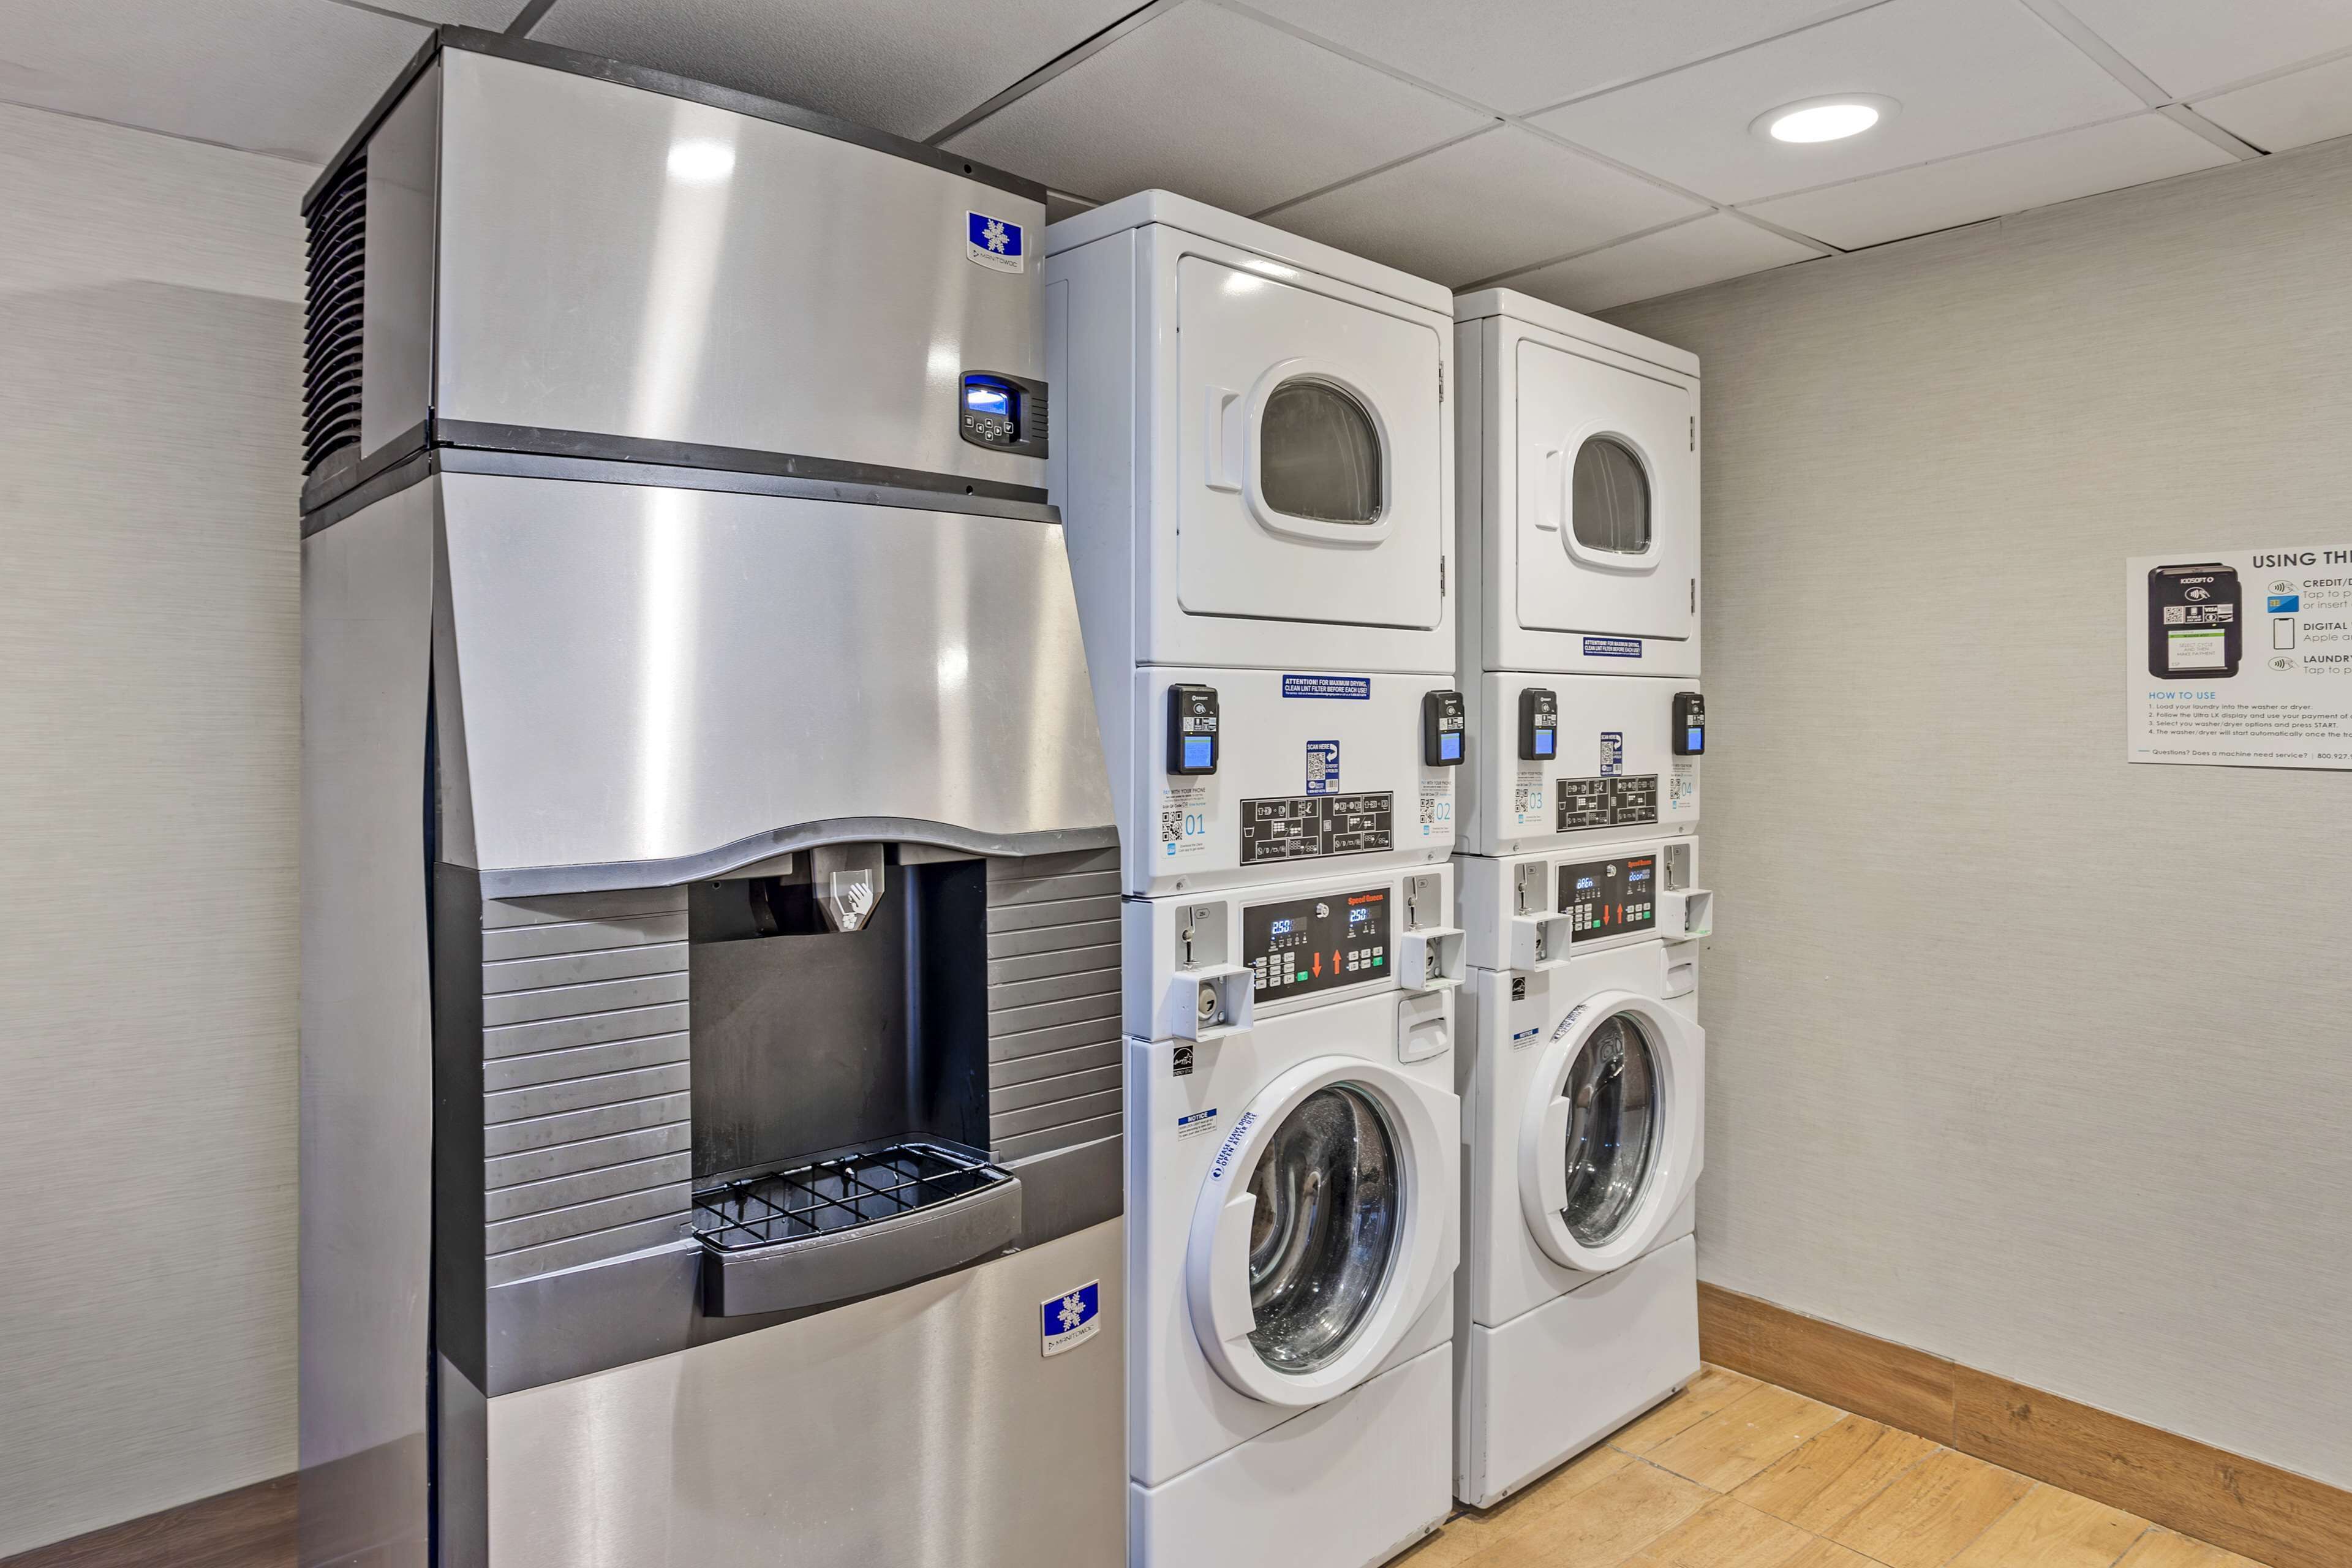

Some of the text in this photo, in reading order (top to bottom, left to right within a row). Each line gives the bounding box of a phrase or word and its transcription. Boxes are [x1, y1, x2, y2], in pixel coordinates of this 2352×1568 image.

[980, 253, 1017, 268] MANITOWOC
[2253, 550, 2352, 568] USING TH
[2304, 666, 2324, 675] Tap
[1681, 782, 1692, 796] 04
[1530, 793, 1542, 809] 03
[1436, 803, 1450, 820] 02
[1185, 813, 1205, 835] 01
[1348, 895, 1365, 905] Speed
[1188, 1112, 1208, 1123] NOTICE
[1216, 1111, 1252, 1164] PLEASE LEAVE DOOR
[1221, 1112, 1257, 1166] OPEN AFTER USE
[1056, 1324, 1095, 1346] MANITOWOC
